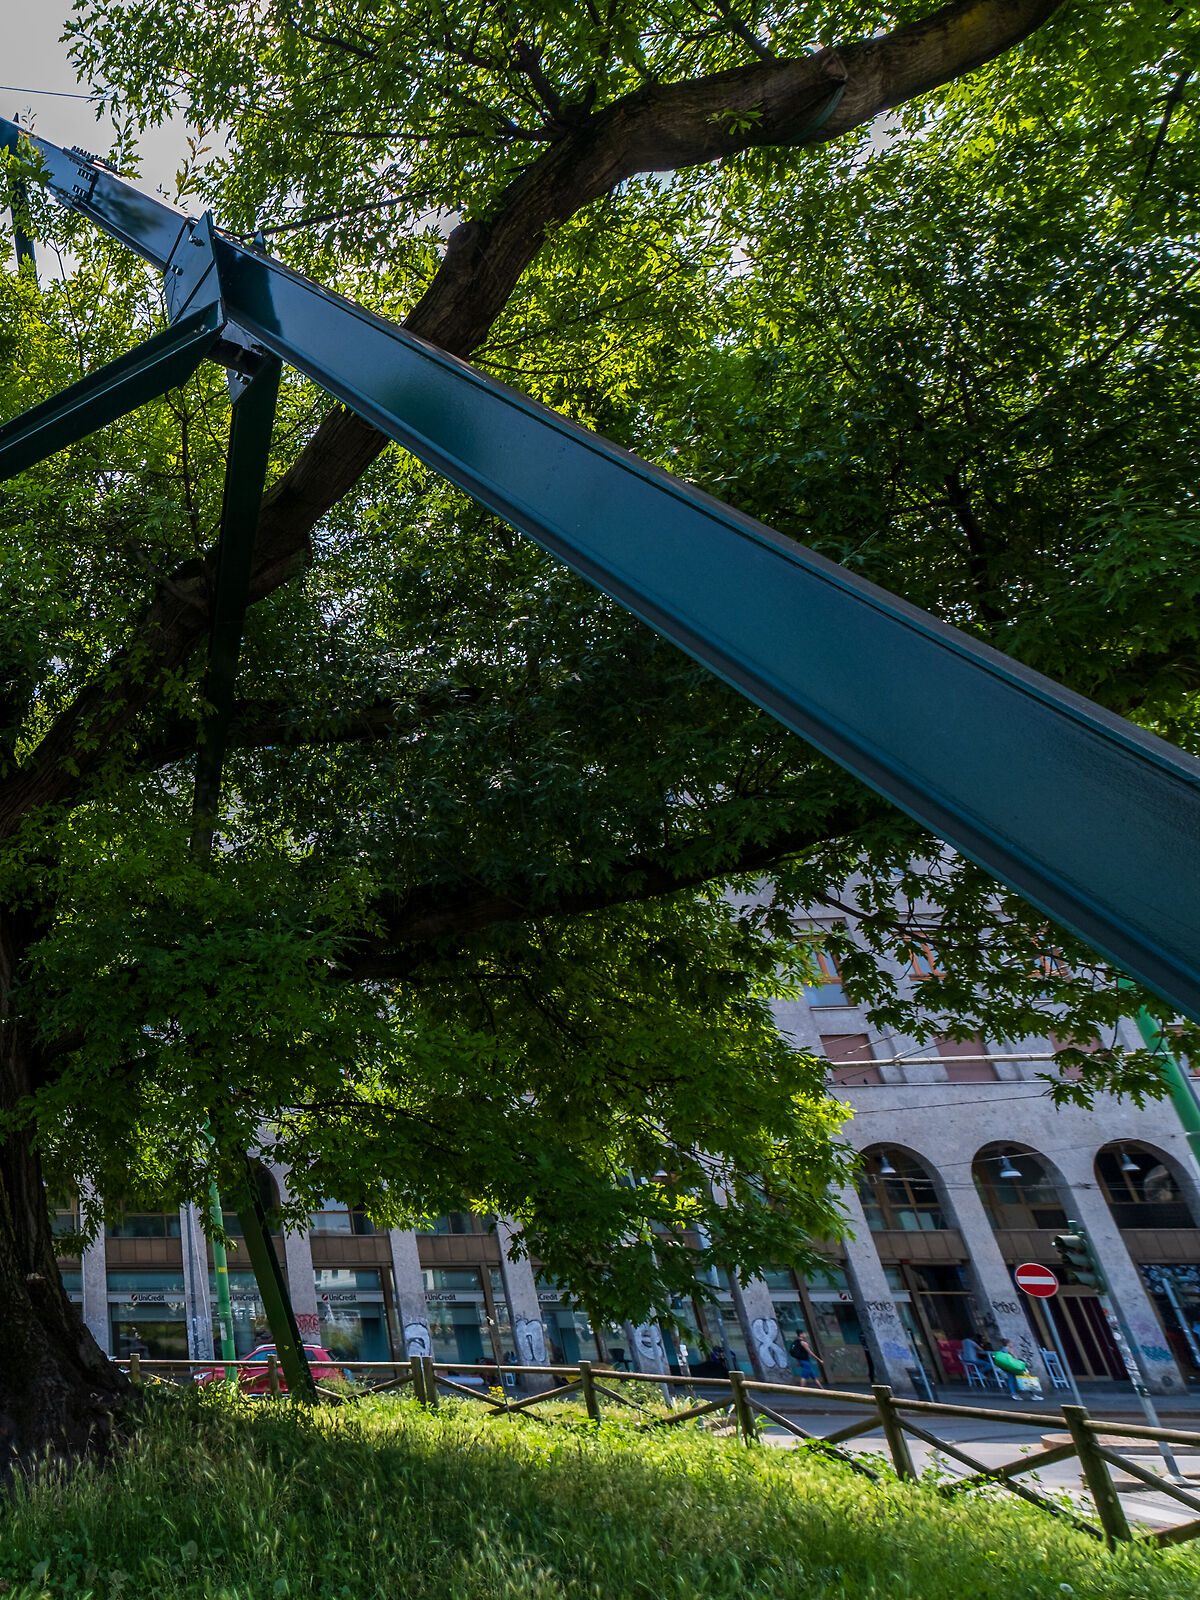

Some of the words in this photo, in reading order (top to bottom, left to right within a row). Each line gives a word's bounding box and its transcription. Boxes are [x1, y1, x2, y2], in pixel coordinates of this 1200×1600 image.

[232, 1294, 260, 1302] UniCredit
[328, 1293, 357, 1301] UniCredit
[427, 1293, 457, 1301] UniCredit
